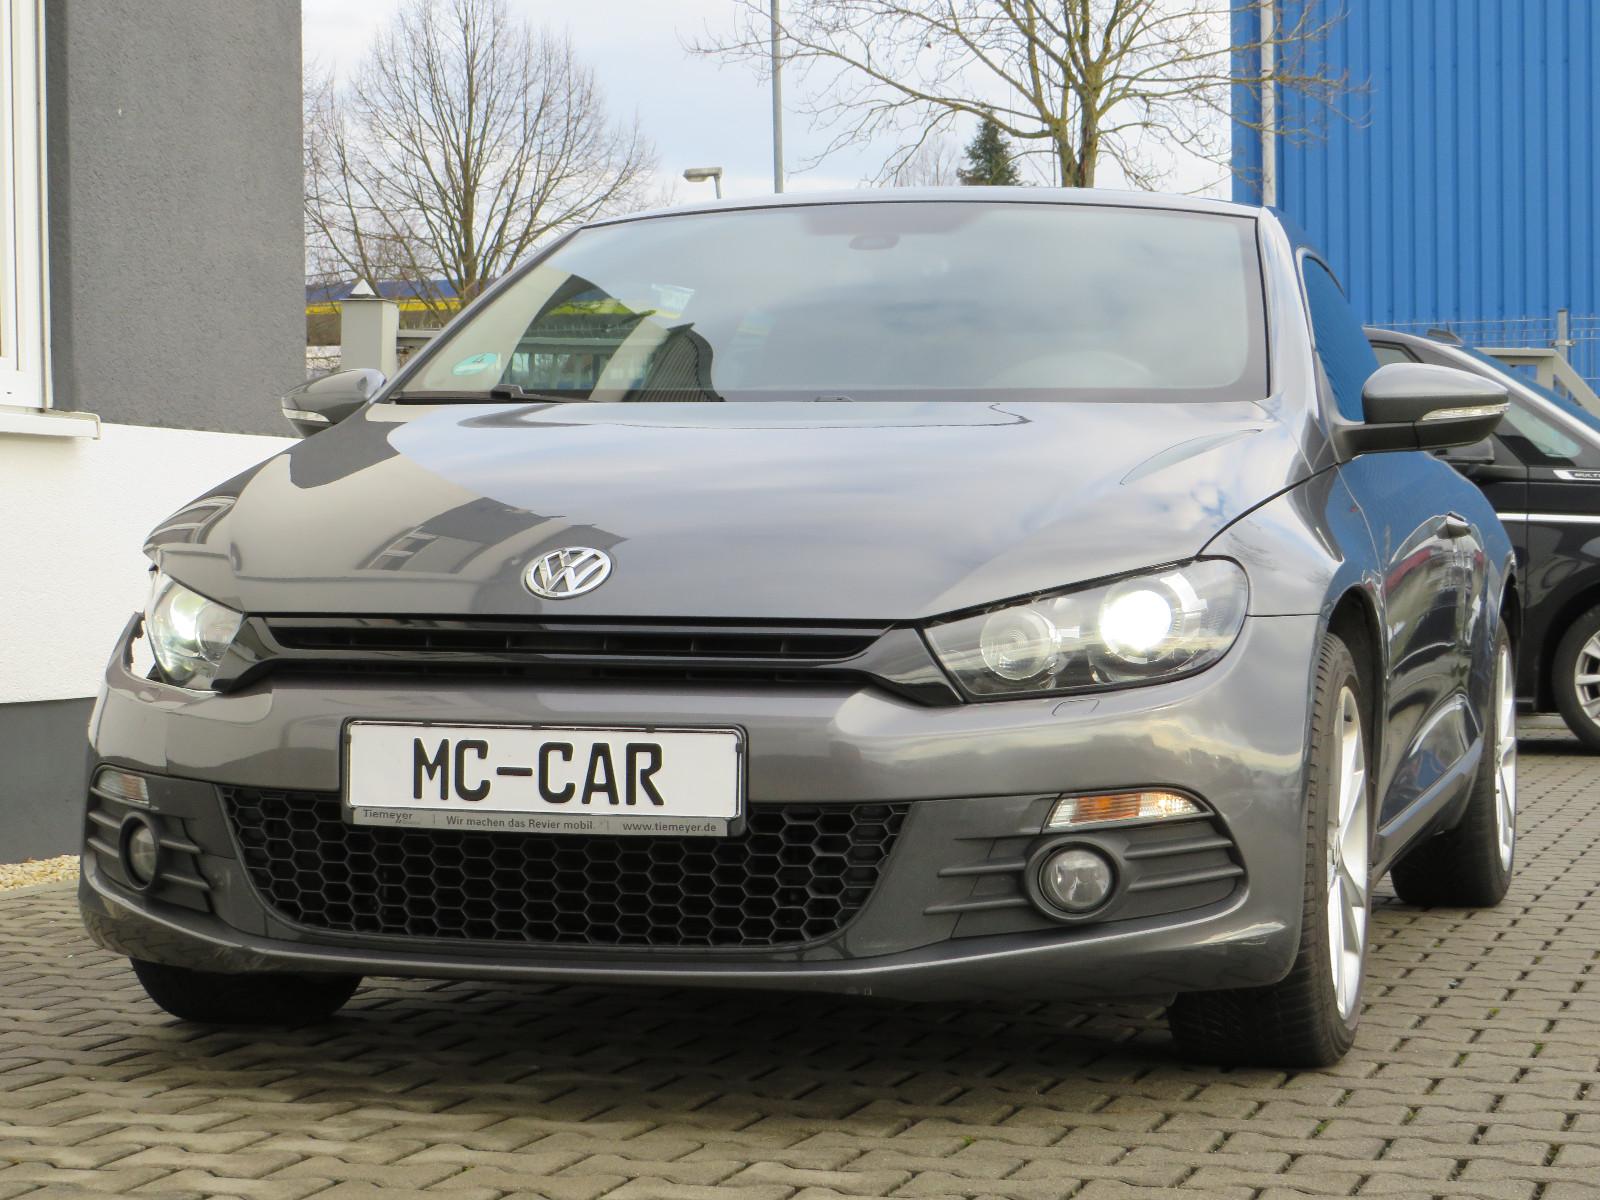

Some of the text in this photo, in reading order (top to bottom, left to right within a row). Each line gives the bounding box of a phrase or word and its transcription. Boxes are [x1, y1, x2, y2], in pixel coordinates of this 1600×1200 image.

[413, 737, 664, 806] MC-CAR
[362, 808, 413, 823] Tiemeyer
[446, 815, 463, 826] Wir
[466, 816, 505, 827] machen
[508, 817, 525, 828] das
[528, 819, 561, 830] Revier
[622, 821, 717, 834] www.tiemeyer.de
